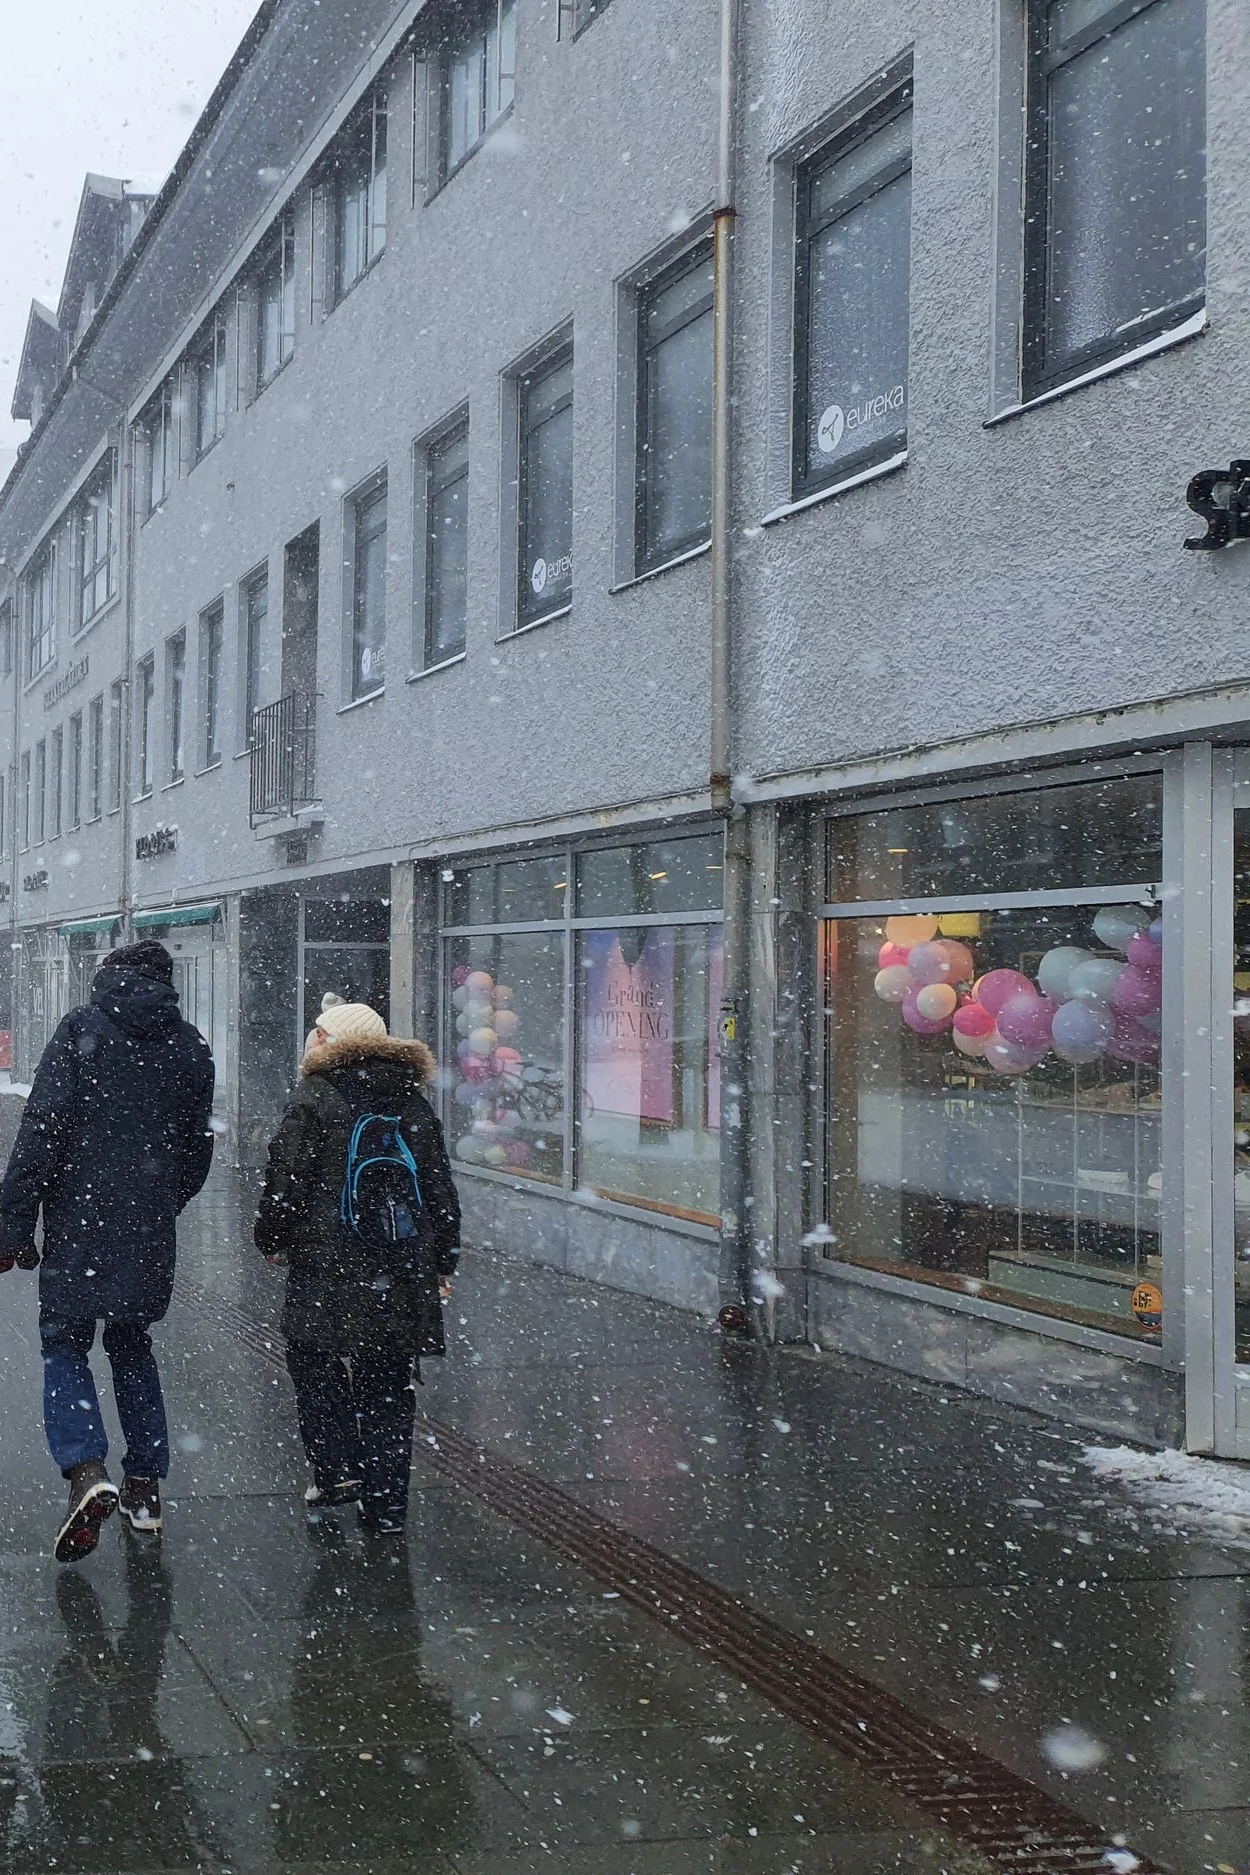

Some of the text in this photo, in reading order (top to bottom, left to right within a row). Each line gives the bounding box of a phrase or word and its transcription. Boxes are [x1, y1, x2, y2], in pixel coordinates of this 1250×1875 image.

[847, 385, 904, 429] eureka
[608, 980, 654, 1008] Grand
[594, 1011, 669, 1041] OPENING
